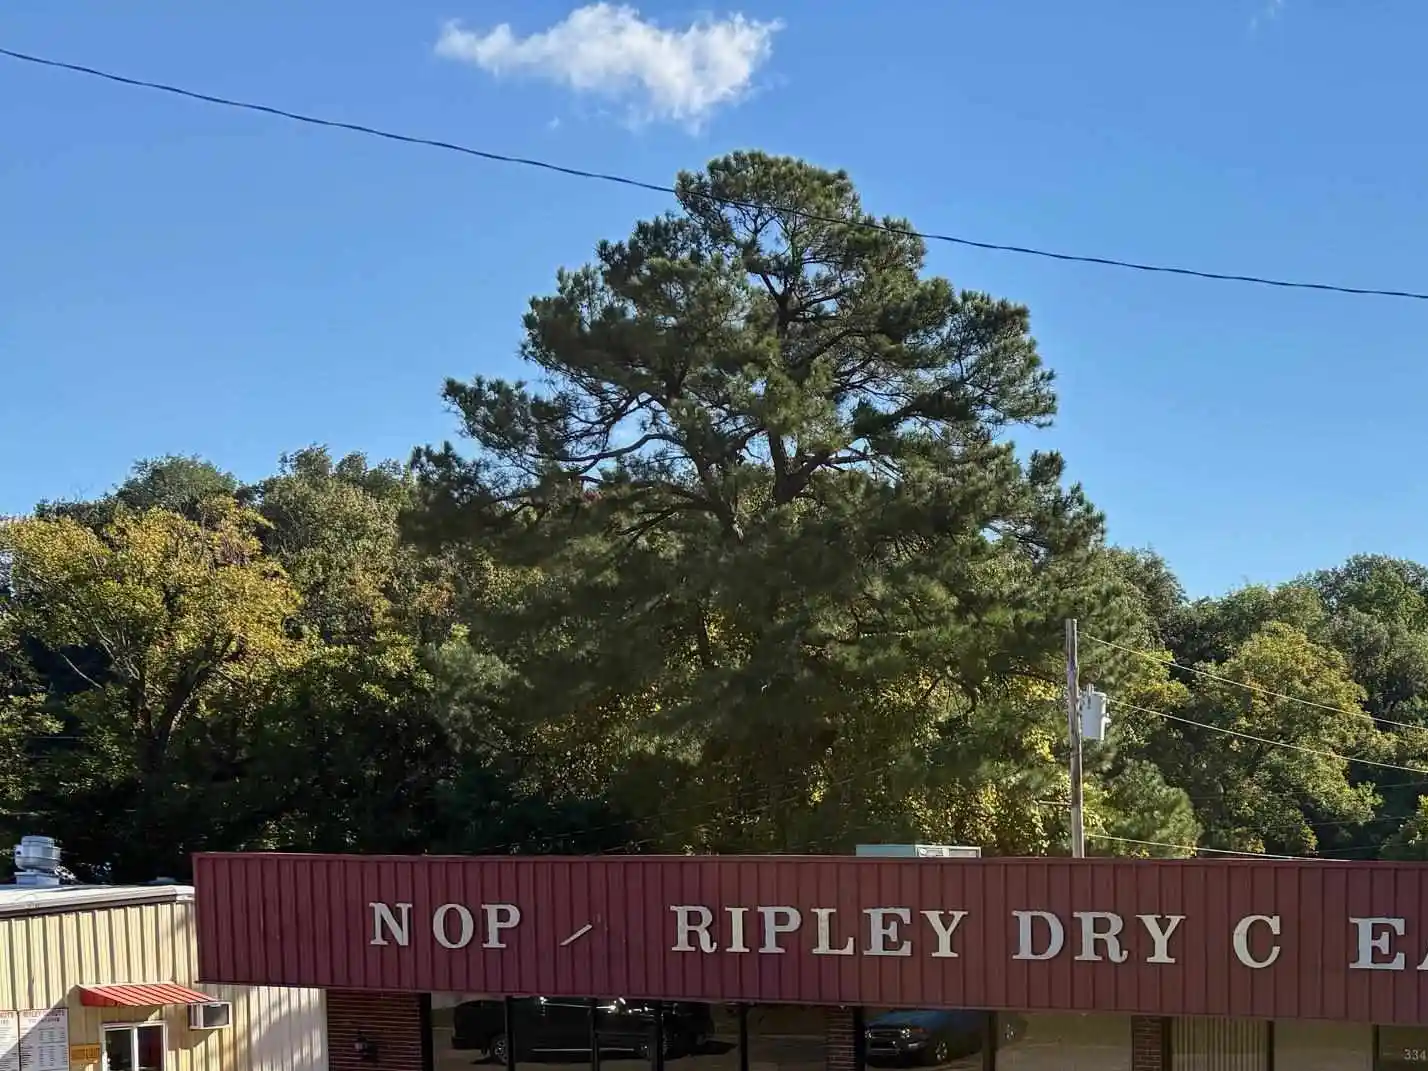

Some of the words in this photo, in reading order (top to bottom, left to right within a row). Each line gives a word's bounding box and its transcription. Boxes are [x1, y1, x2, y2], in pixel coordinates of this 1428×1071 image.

[669, 905, 969, 958] RIPLEY
[1011, 910, 1186, 964] DRY
[1403, 1049, 1427, 1061] 334
